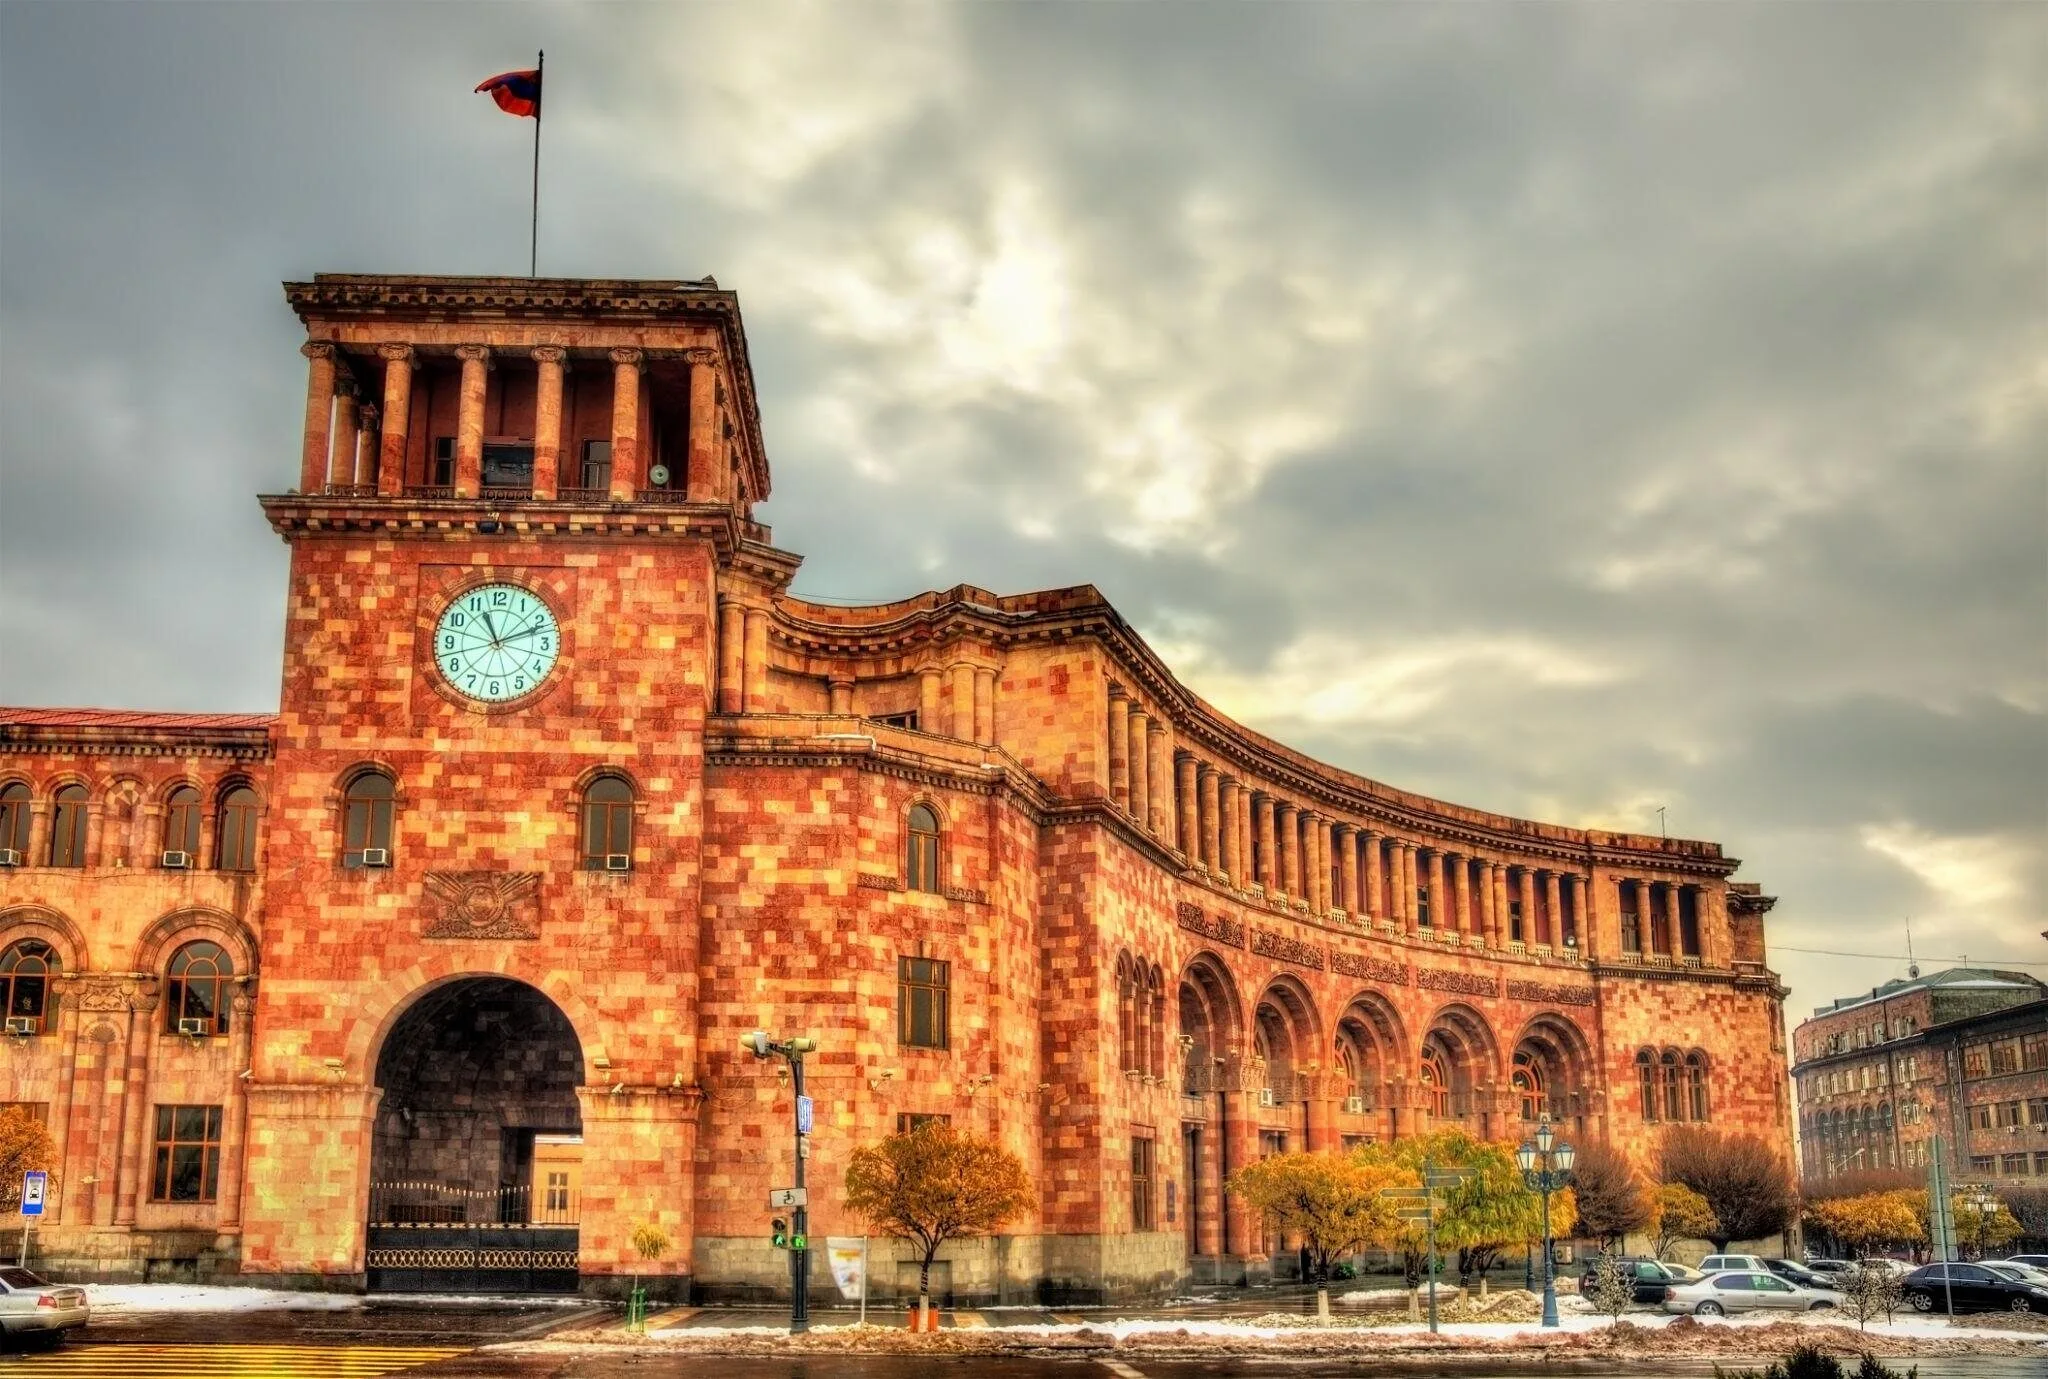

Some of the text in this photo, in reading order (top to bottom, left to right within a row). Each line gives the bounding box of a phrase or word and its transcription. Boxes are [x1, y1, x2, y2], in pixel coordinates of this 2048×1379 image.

[470, 597, 481, 611] 11
[493, 592, 507, 606] 12
[521, 598, 525, 612] 1
[450, 613, 464, 627] 10
[535, 614, 544, 628] 2
[445, 635, 454, 649] 9
[540, 637, 549, 650] 3
[450, 658, 459, 671] 8
[533, 659, 541, 673] 4
[467, 674, 476, 688] 7
[490, 681, 499, 695] 6
[515, 676, 524, 689] 5
